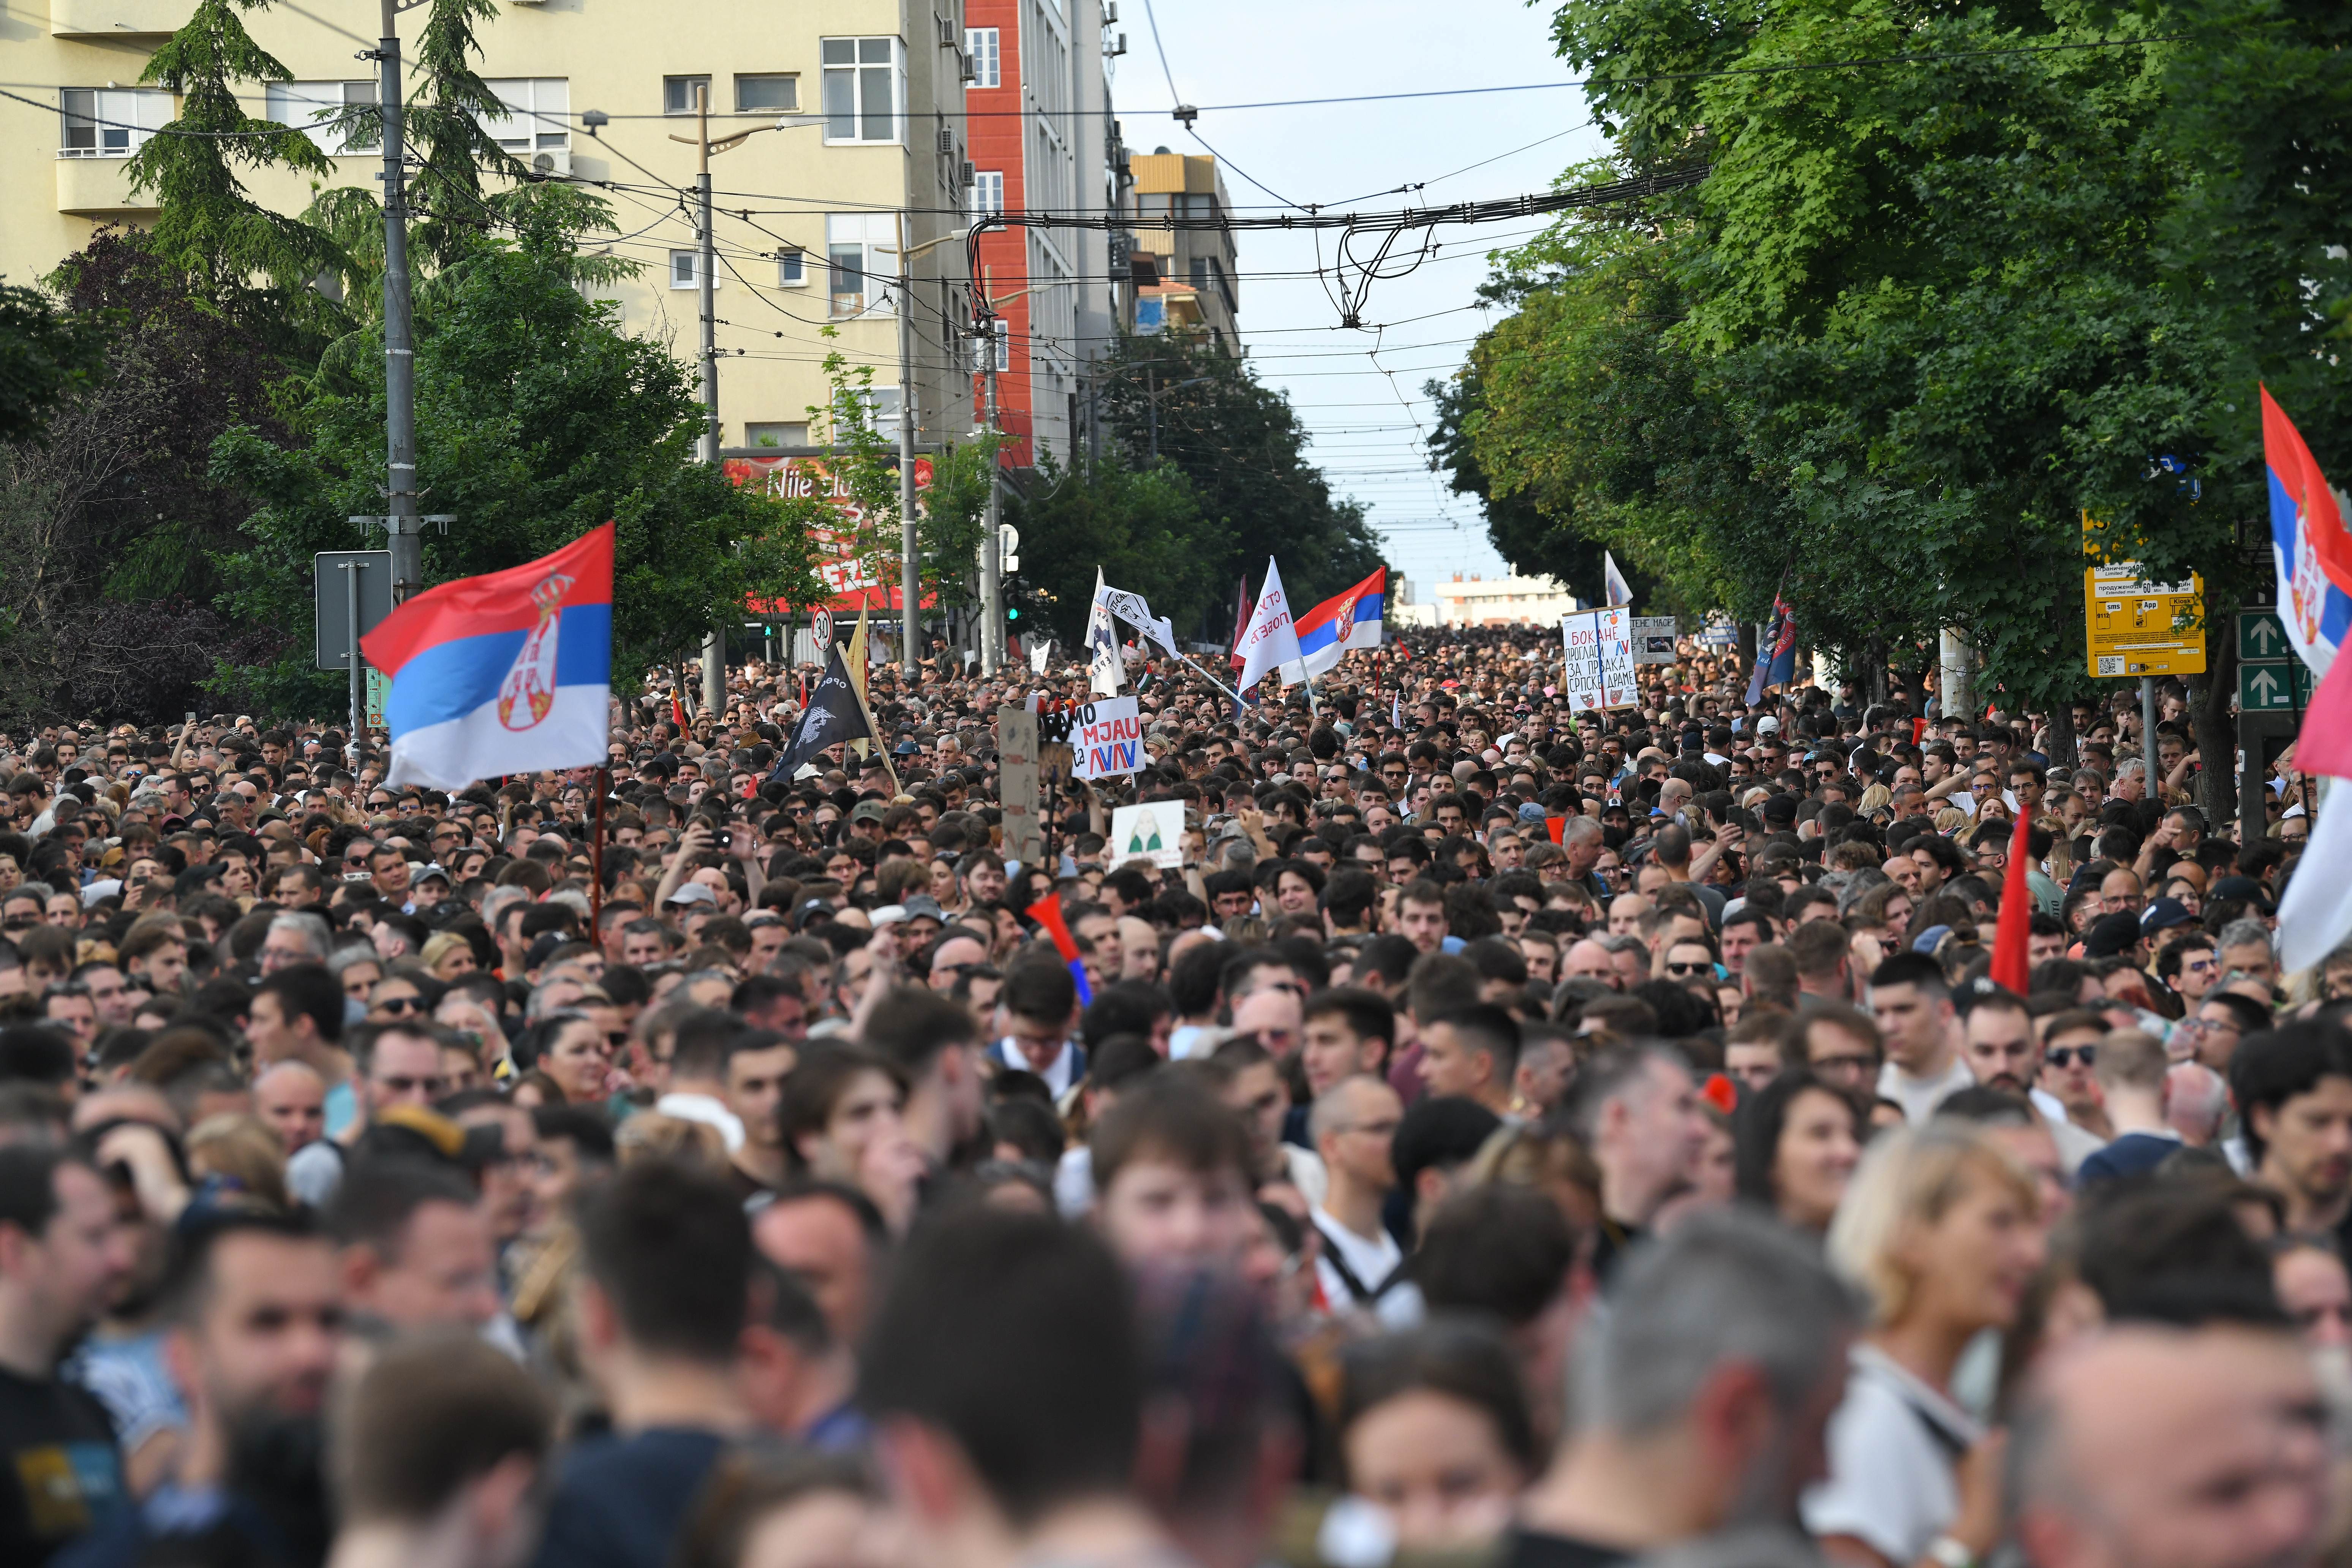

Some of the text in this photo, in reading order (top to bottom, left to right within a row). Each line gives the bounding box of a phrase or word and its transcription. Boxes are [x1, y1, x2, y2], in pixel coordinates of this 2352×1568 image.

[2143, 583, 2151, 593] 60
[816, 617, 828, 639] 30
[1653, 619, 1672, 627] МАСЕ
[1572, 626, 1619, 645] БОКАНЕ
[1565, 644, 1604, 662] ПРОГЛАСИ
[1568, 663, 1582, 677] ЗА
[1588, 657, 1626, 675] ПРВАКА
[1570, 671, 1634, 692] СРПСКЕ ДРАМЕ
[1083, 716, 1140, 746] MJAU
